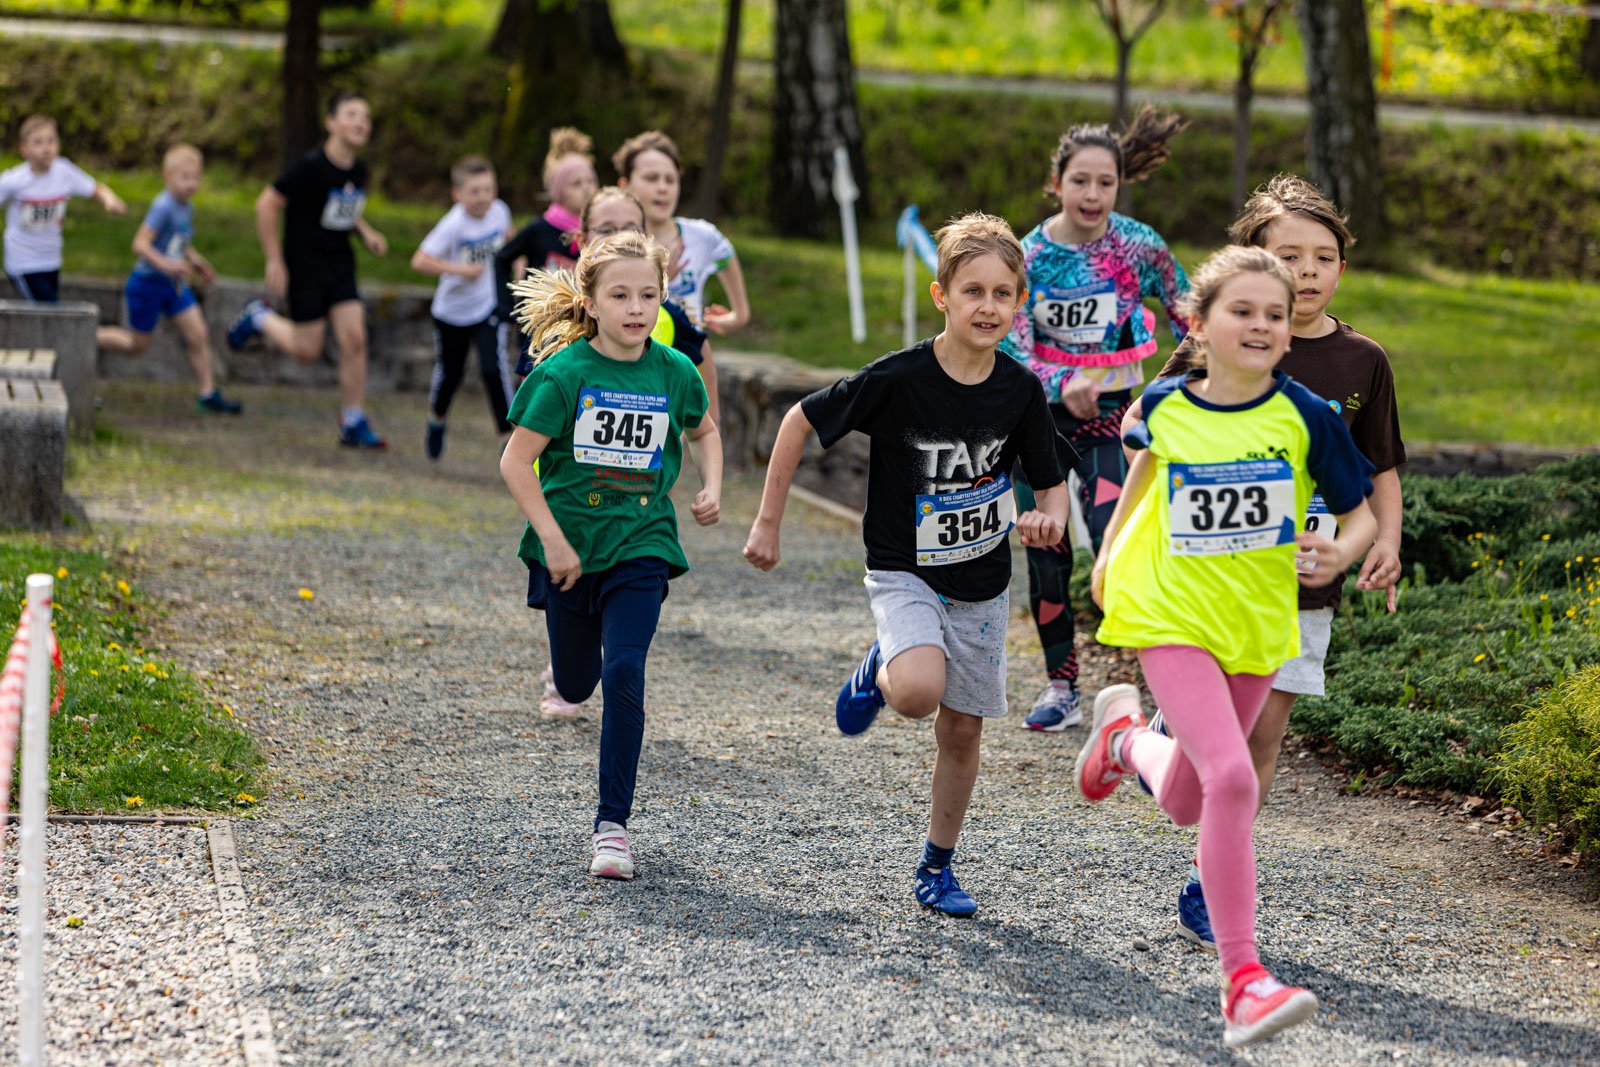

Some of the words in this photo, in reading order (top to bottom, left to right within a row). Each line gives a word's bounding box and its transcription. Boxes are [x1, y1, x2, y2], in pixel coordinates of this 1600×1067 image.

[1047, 299, 1098, 327] 362
[593, 410, 653, 449] 345
[938, 500, 1001, 546] 354
[1190, 486, 1269, 531] 323
